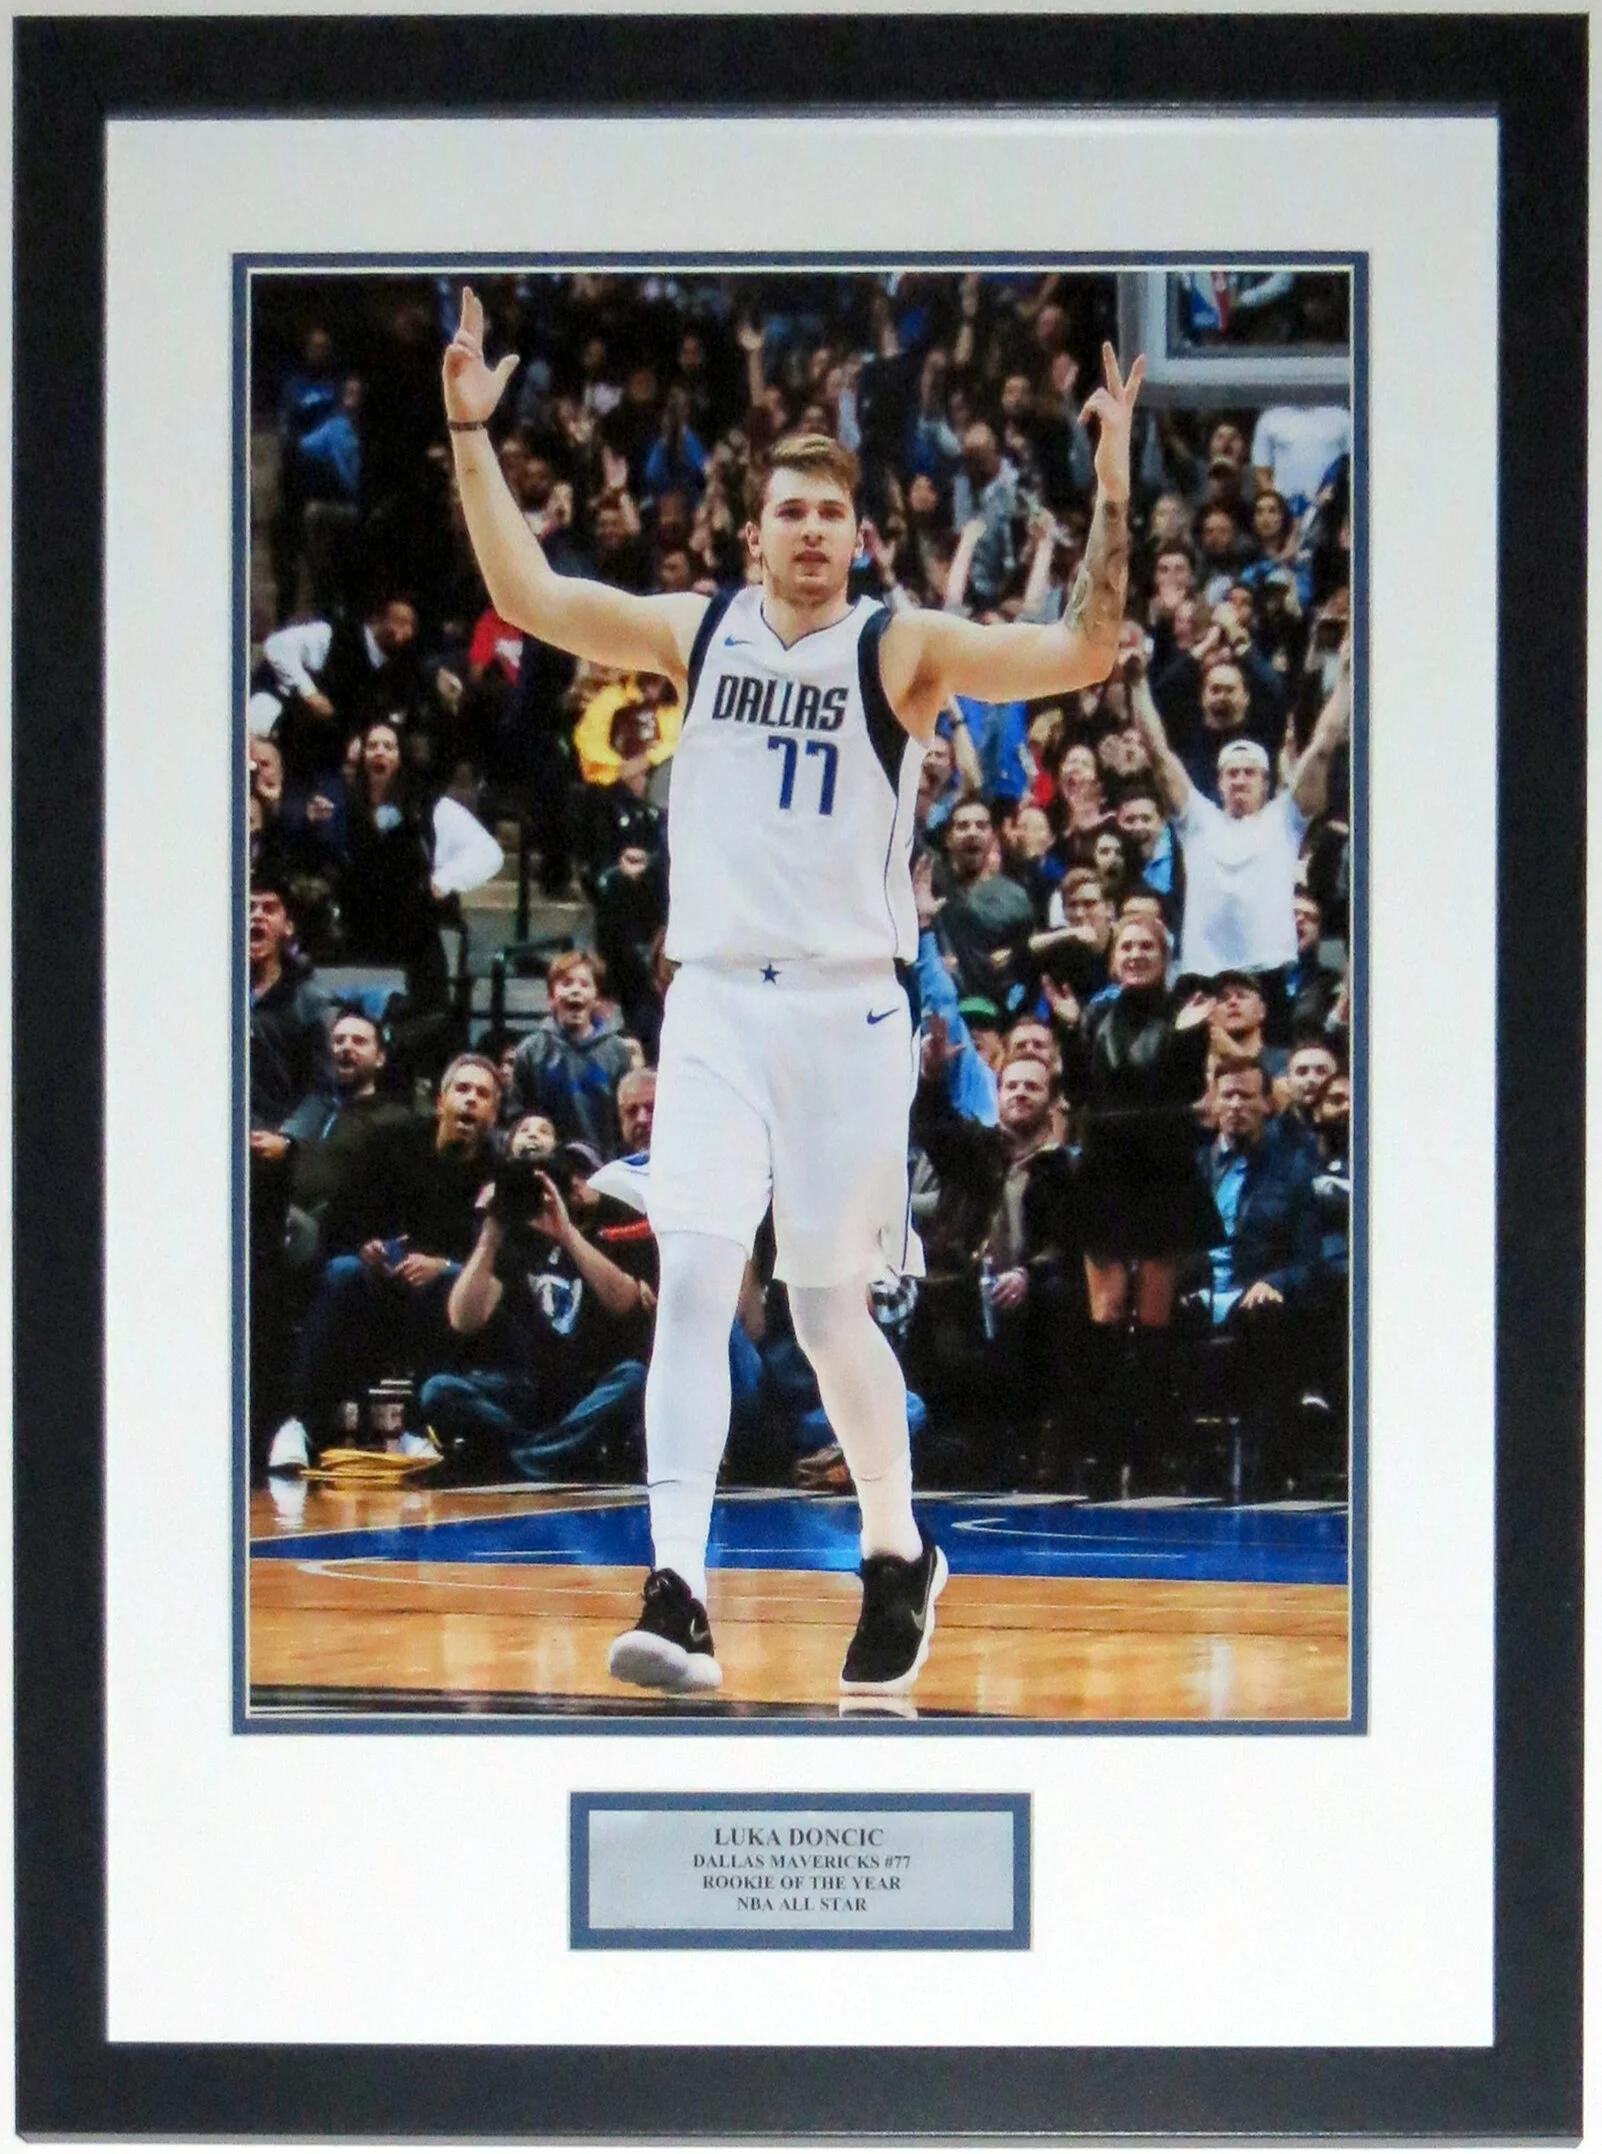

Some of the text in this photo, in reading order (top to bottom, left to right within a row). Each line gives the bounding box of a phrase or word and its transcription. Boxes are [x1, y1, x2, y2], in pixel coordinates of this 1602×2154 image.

[711, 674, 849, 731] DALLAS
[767, 735, 839, 816] 77
[714, 1828, 885, 1847] LUKA DONCIC
[693, 1853, 911, 1870] DALLAS MAVERICKS #77
[702, 1875, 901, 1891] ROOKIE OF THE YEAR
[736, 1897, 868, 1912] NBA ALL STAR
